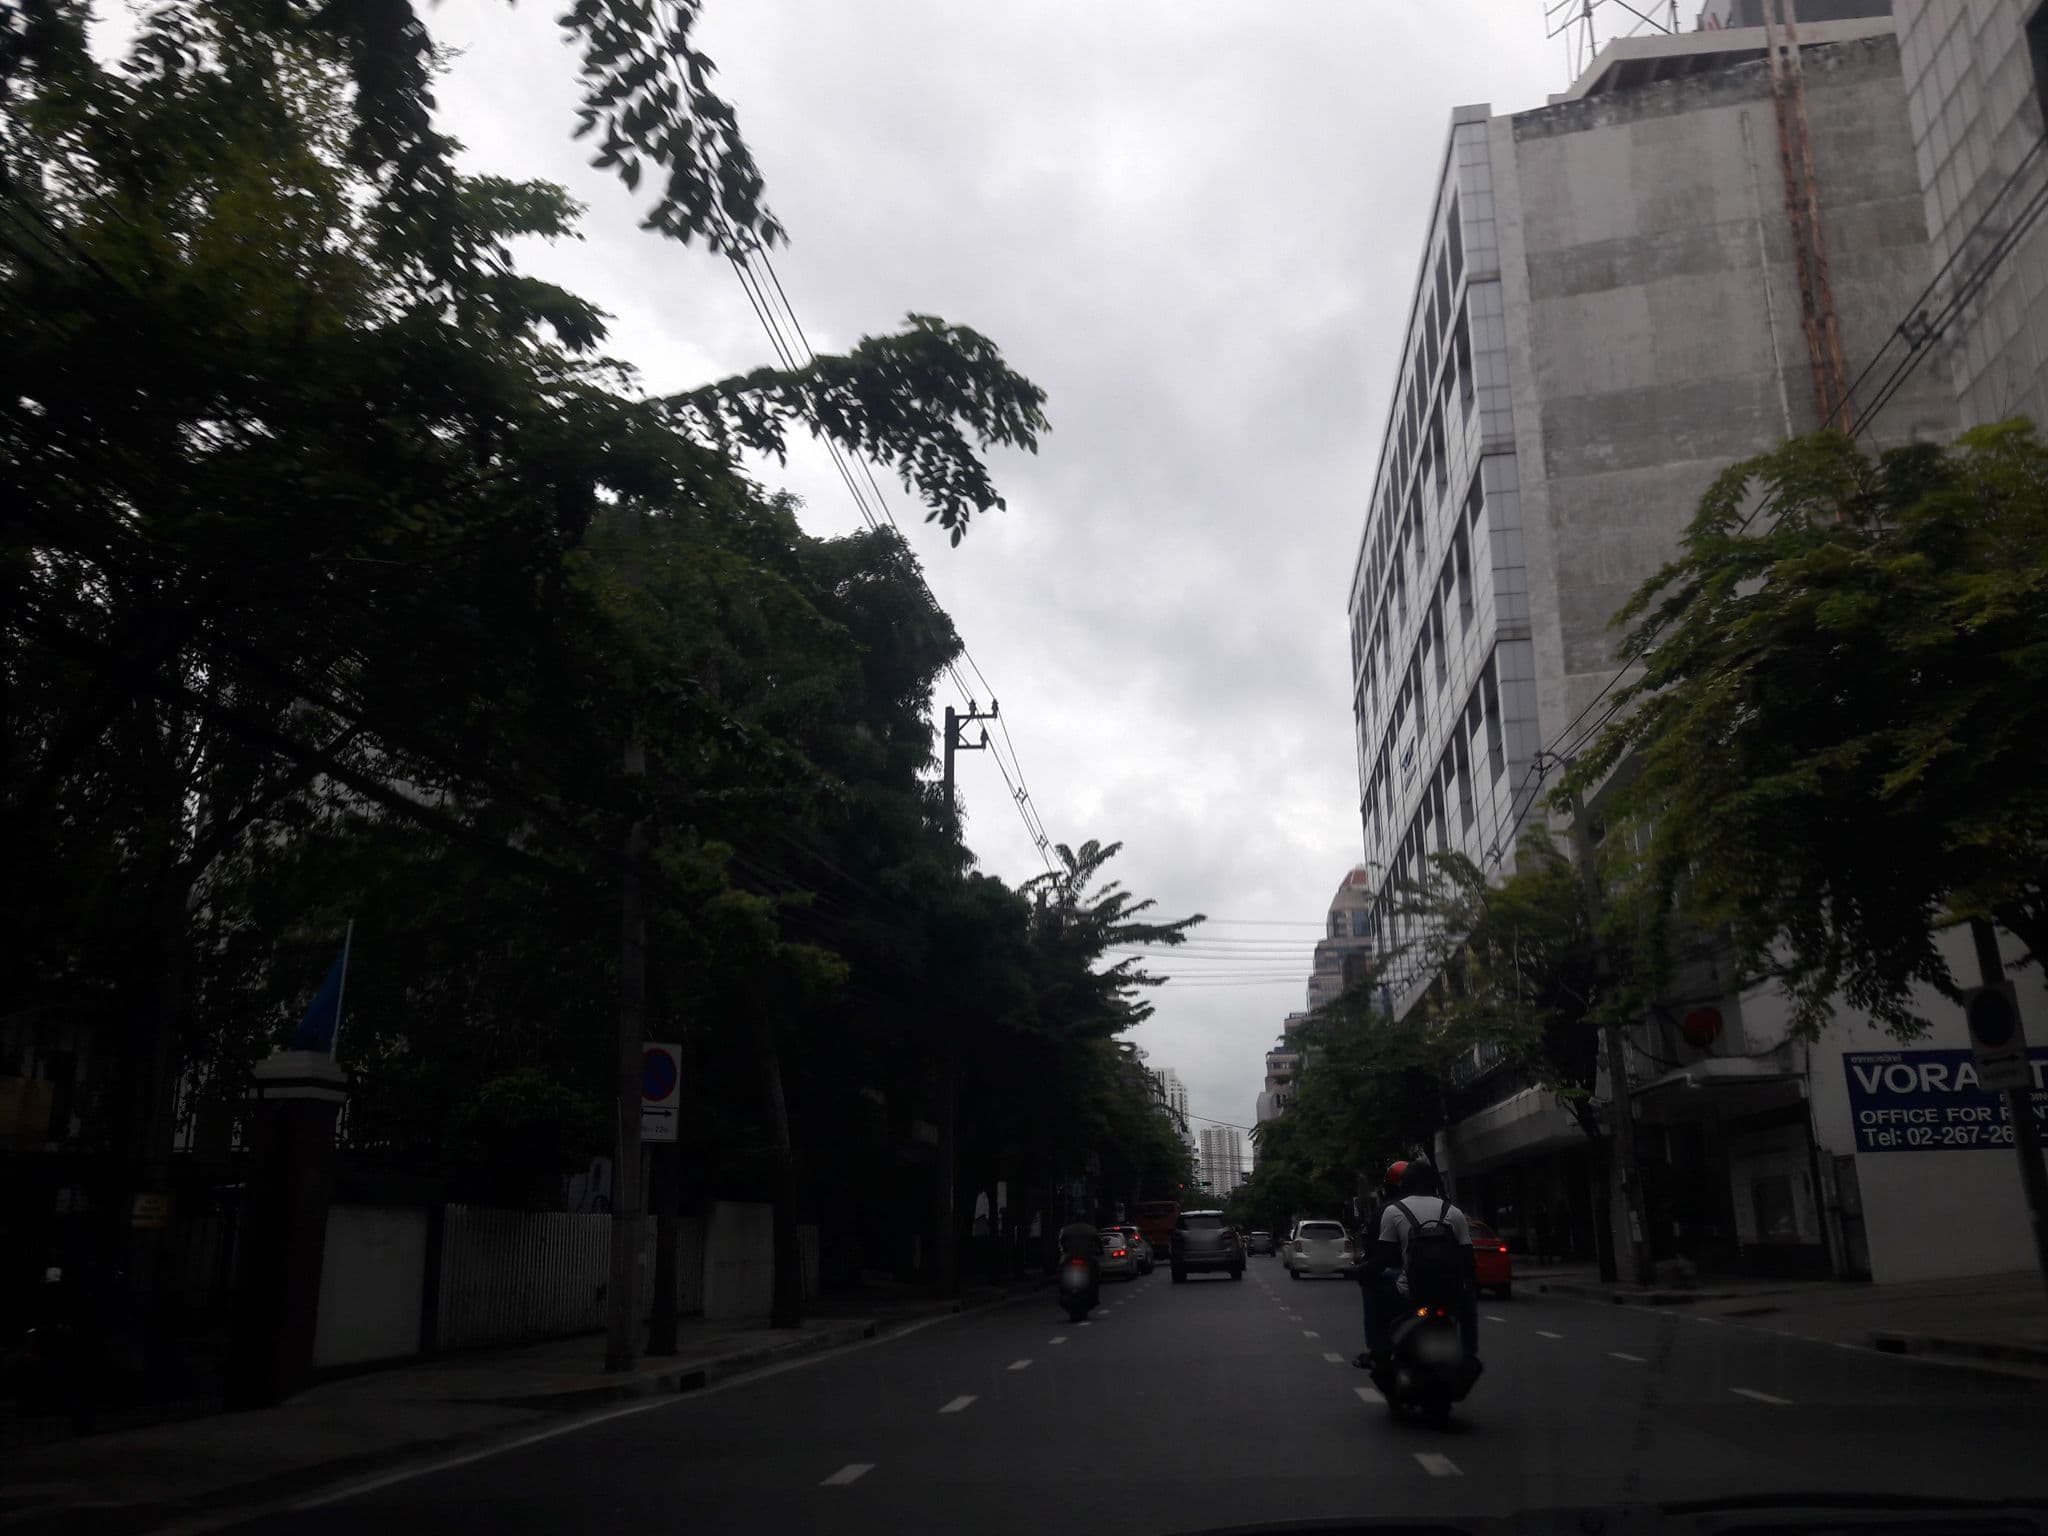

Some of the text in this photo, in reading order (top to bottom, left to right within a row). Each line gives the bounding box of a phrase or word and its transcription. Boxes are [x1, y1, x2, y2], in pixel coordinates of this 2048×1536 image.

[1859, 1108, 1939, 1125] OFFICE
[1946, 1106, 1992, 1122] FOR
[1862, 1126, 1902, 1147] Tel:
